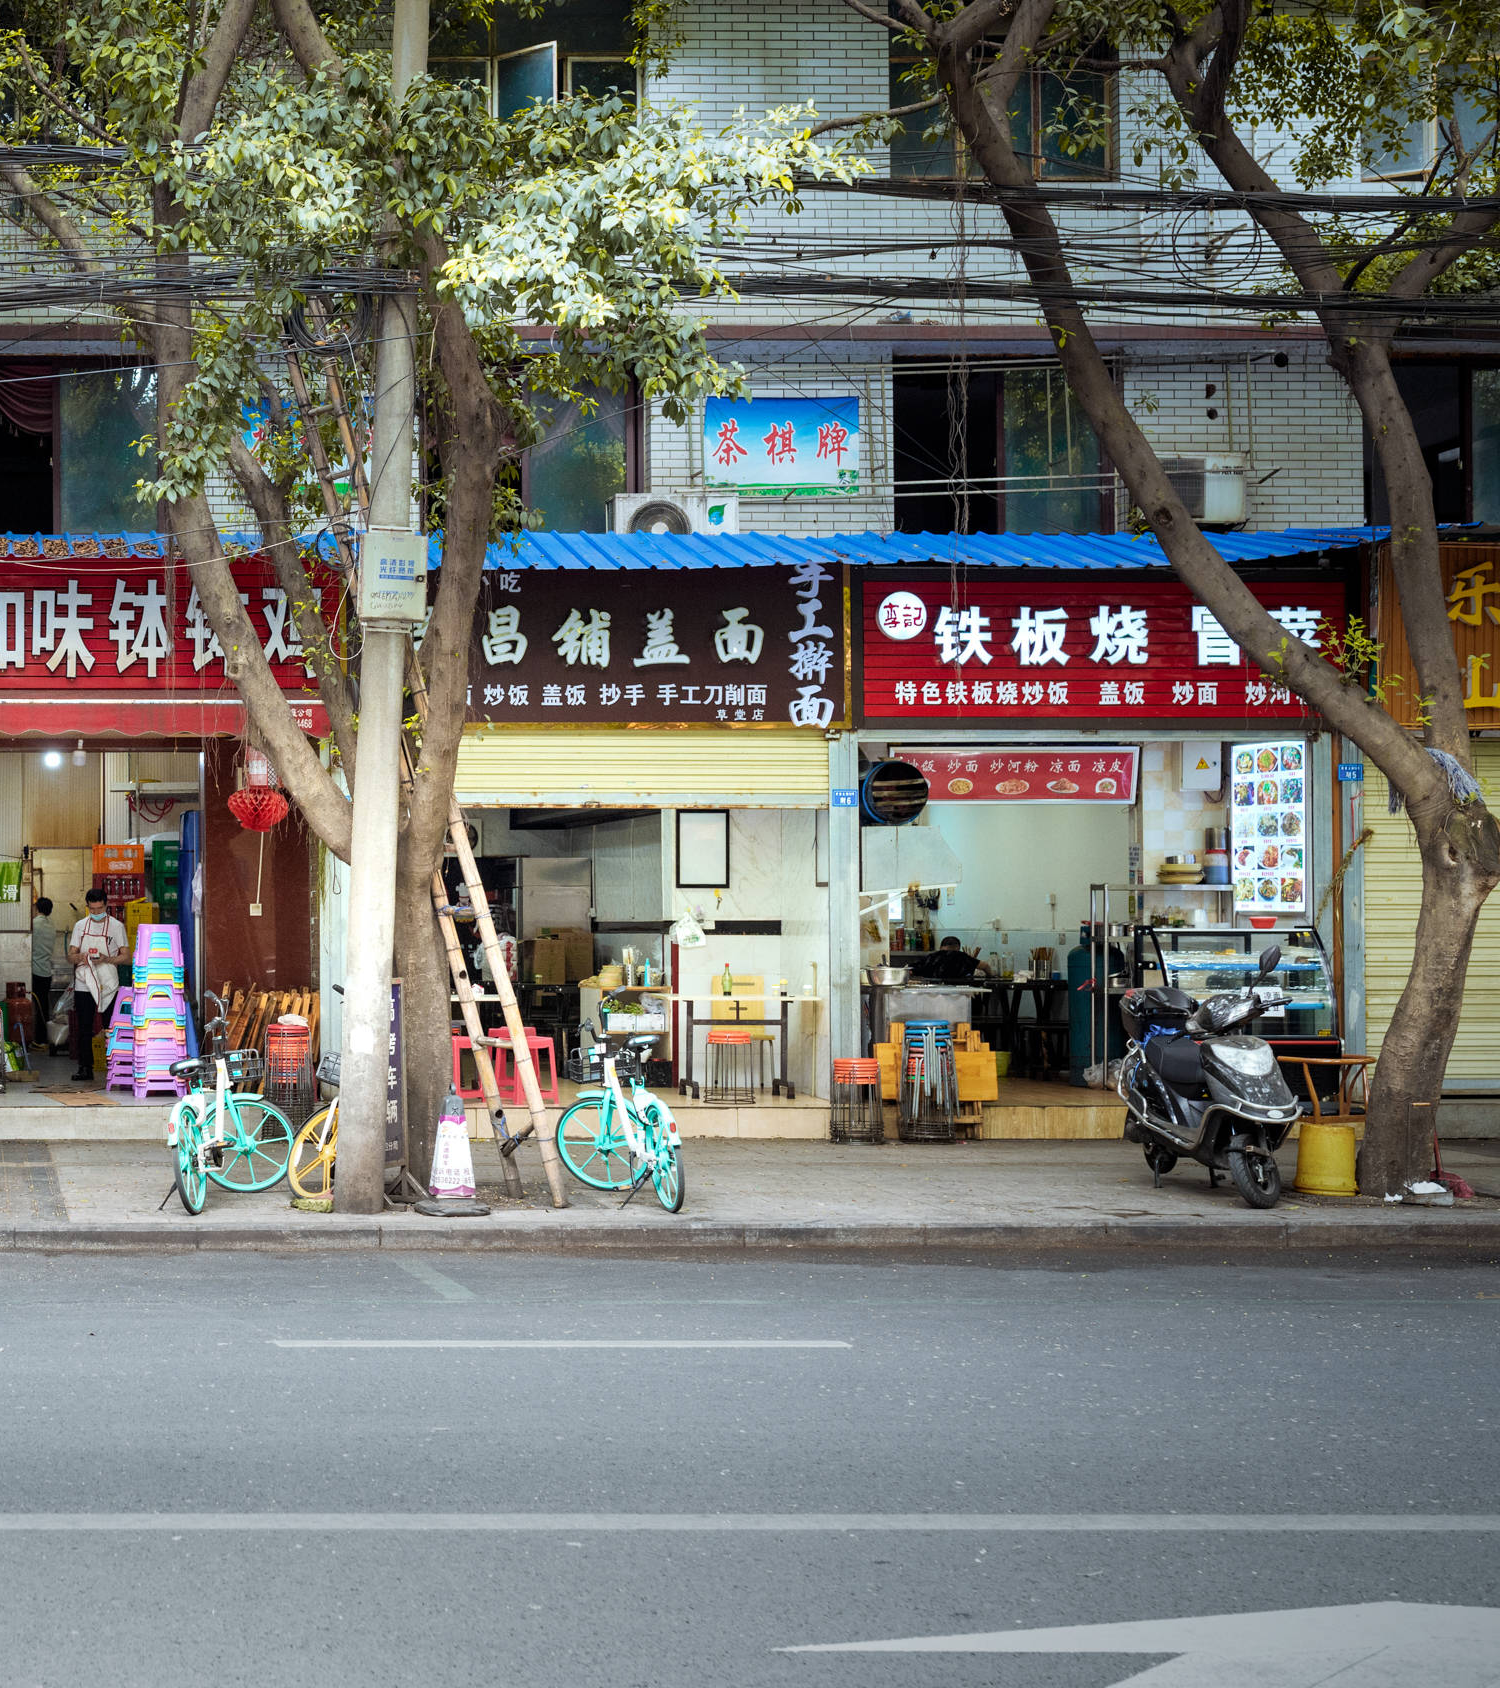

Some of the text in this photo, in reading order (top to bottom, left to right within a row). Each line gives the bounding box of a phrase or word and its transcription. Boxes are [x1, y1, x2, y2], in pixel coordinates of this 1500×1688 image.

[712, 418, 849, 467] 茶棋牌
[411, 604, 765, 669] 昌铺盖面
[933, 605, 1150, 666] 铁板烧
[483, 684, 529, 706] 炒饭
[541, 684, 587, 706] 盖饭
[600, 684, 646, 706] 抄手
[656, 684, 768, 706] 手工刀削面
[895, 681, 1306, 705] 特色铁板烧炒饭 盖饭 炒面 炒河
[715, 709, 765, 721] 草堂店
[947, 758, 978, 774] 炒面
[989, 759, 1039, 774] 炒河粉
[1050, 758, 1081, 773] 凉面
[1092, 758, 1124, 774] 凉皮
